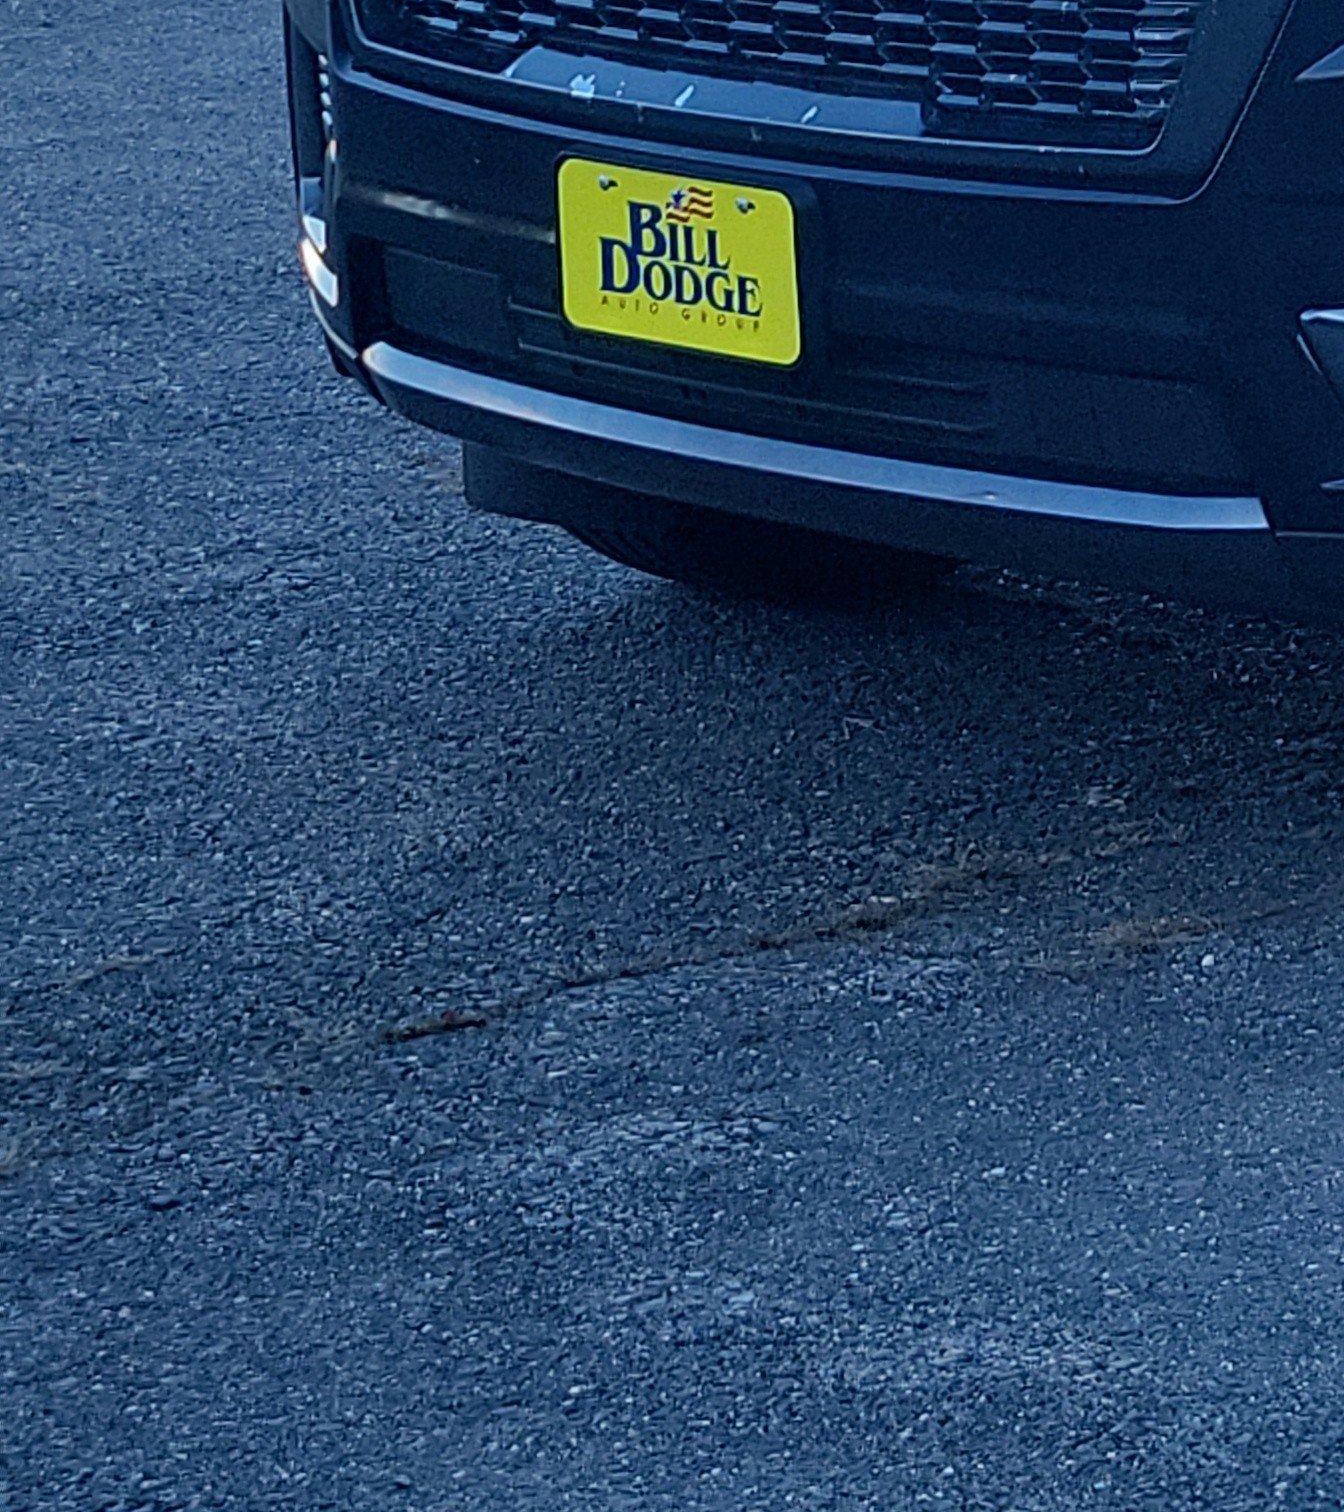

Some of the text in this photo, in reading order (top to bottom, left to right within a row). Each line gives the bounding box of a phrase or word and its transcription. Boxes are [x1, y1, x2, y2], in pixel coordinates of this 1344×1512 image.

[627, 200, 731, 271] BILL
[599, 236, 764, 318] DODGE
[601, 294, 760, 333] AUTO GROUP
